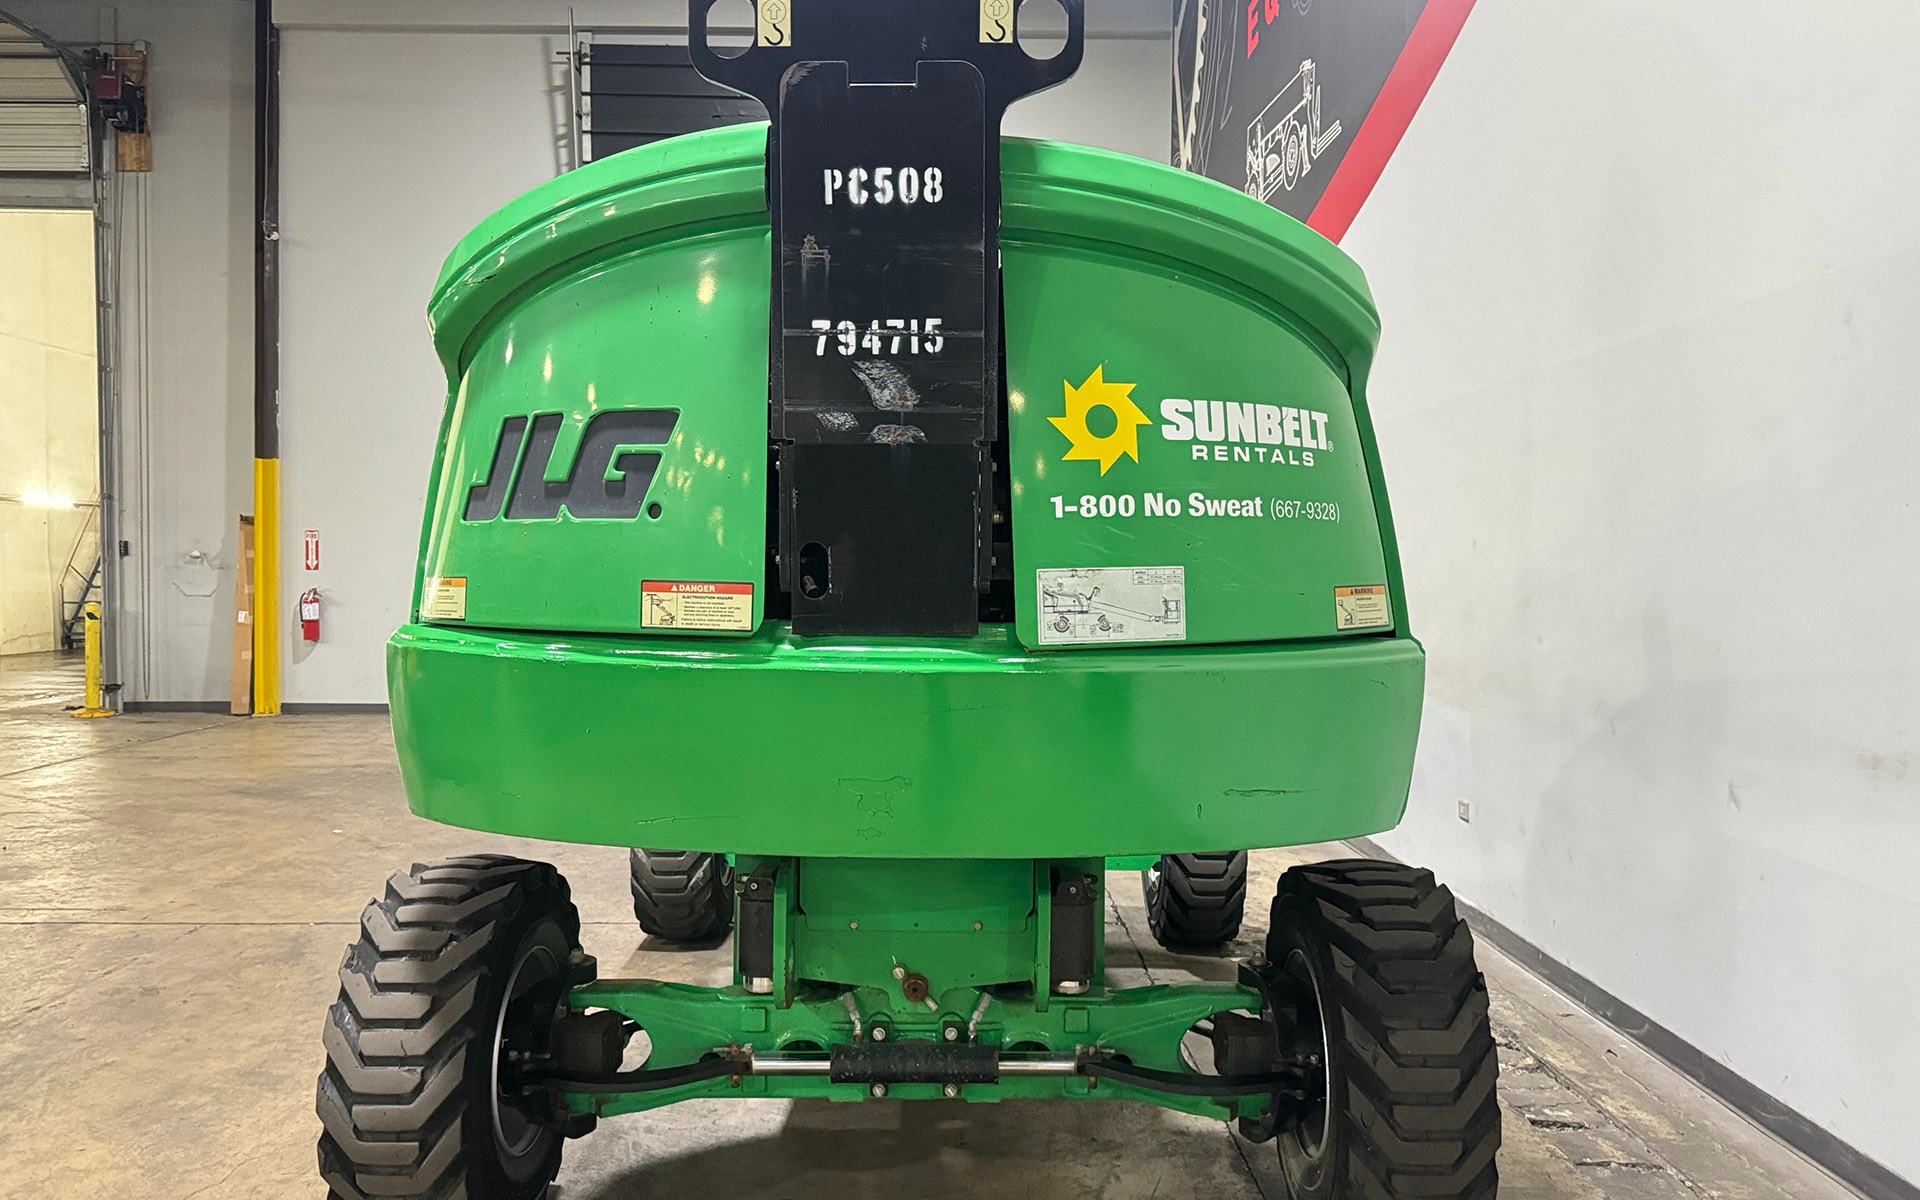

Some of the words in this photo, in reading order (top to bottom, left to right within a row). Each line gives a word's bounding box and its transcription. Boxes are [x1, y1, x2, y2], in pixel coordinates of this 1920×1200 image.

[824, 167, 943, 205] PC508
[811, 317, 944, 356] 794715
[1191, 444, 1314, 467] RENTALS
[1050, 494, 1135, 518] 1-800
[1143, 492, 1182, 517] No
[1188, 492, 1263, 517] Sweat
[1270, 498, 1340, 524] (667-9328)
[679, 584, 716, 592] DANGER
